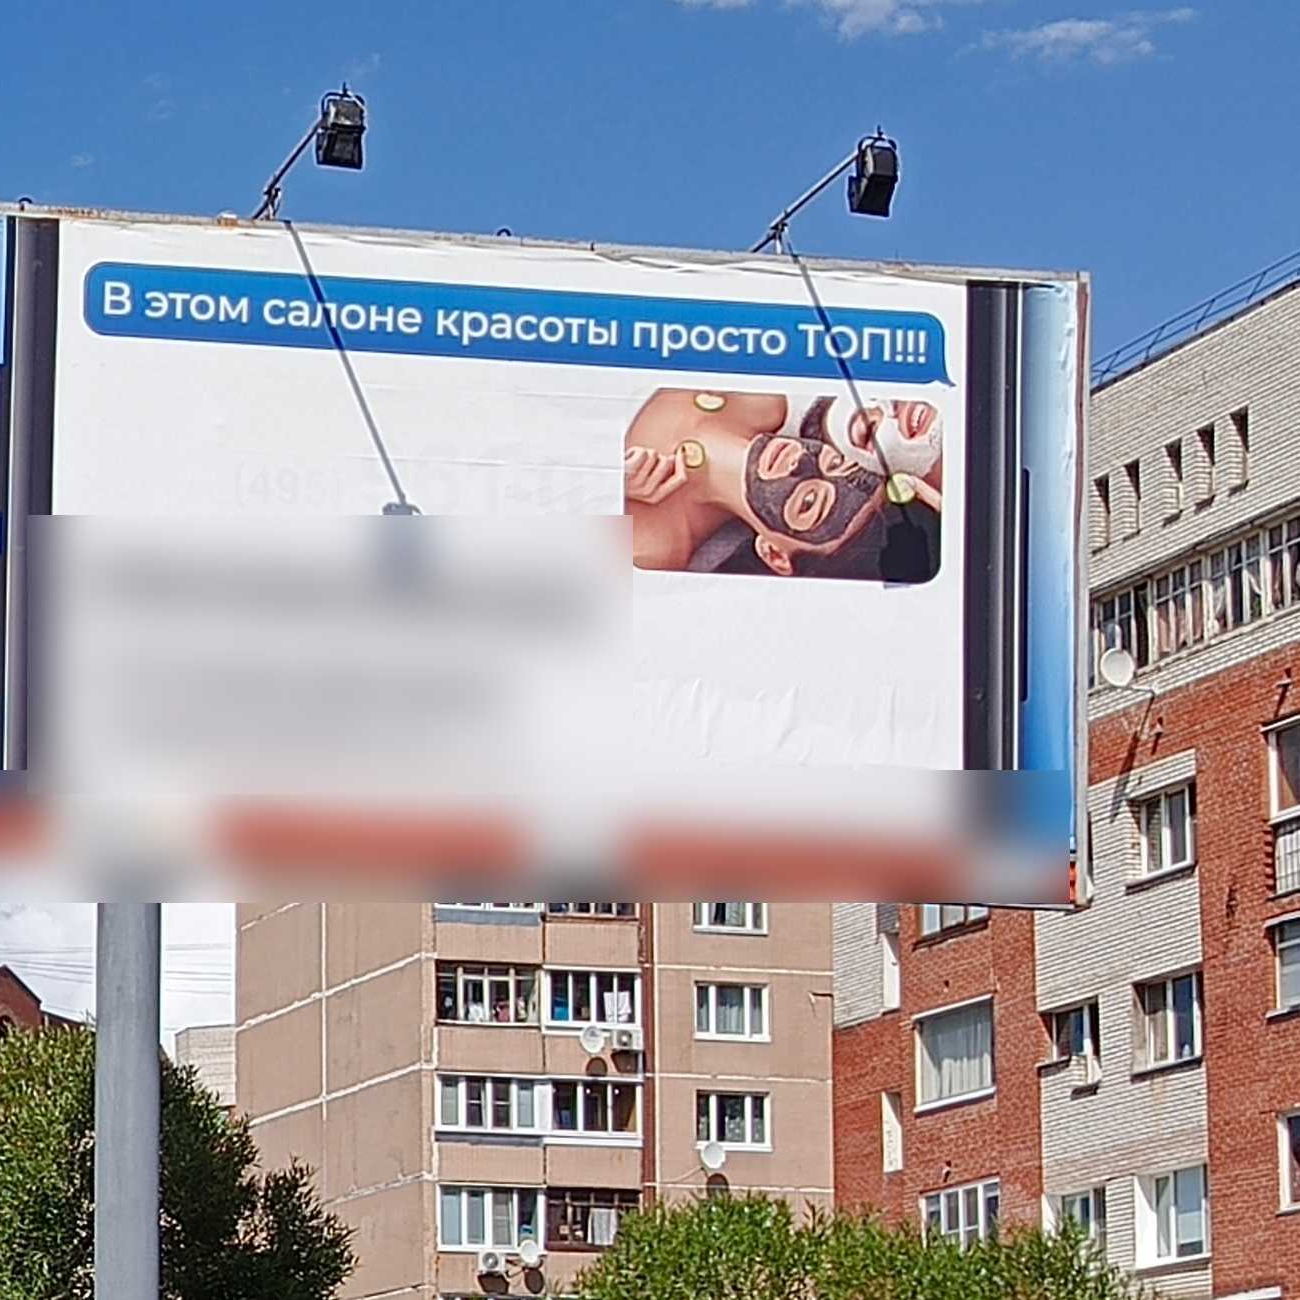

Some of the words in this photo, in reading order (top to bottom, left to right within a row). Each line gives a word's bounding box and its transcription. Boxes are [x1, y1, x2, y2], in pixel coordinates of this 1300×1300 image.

[103, 281, 132, 316] В
[143, 289, 249, 324] этом
[262, 297, 423, 335] салоне
[436, 307, 619, 347] красоты
[632, 319, 787, 358] просто
[797, 322, 927, 364] ТОП!!!
